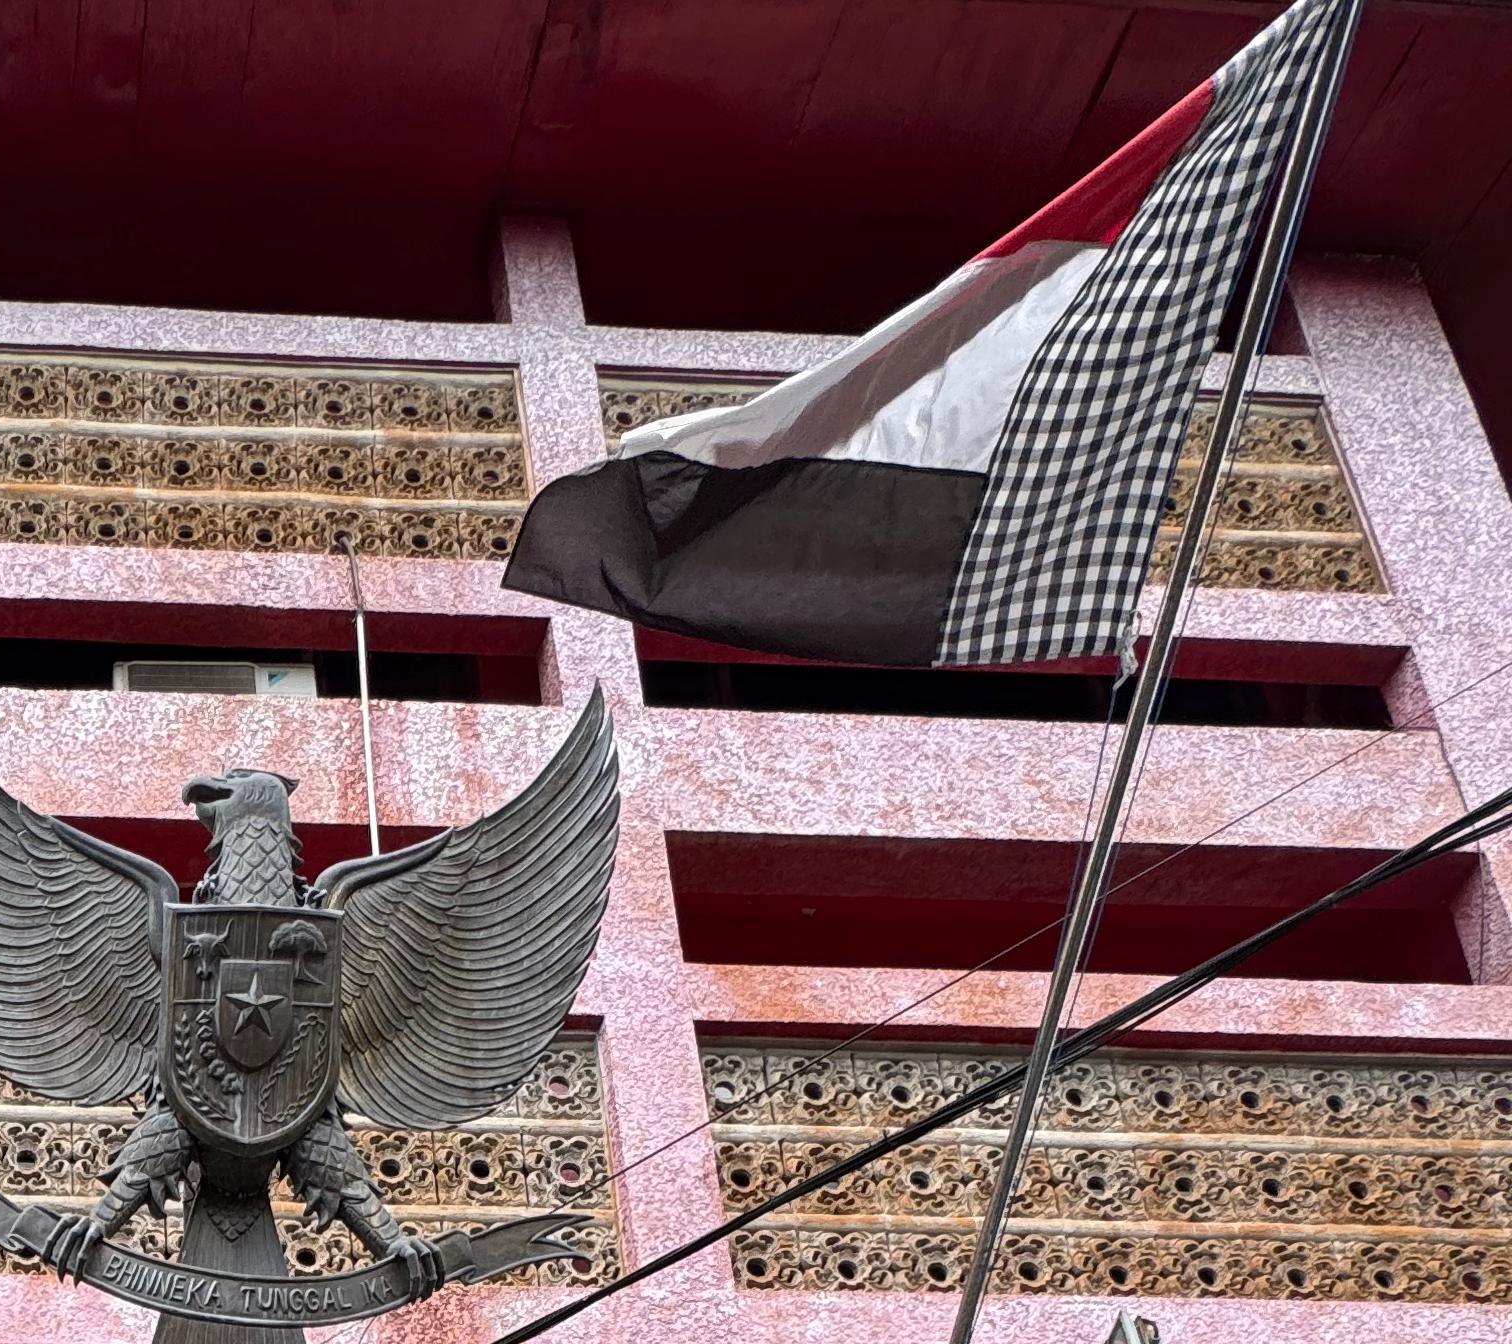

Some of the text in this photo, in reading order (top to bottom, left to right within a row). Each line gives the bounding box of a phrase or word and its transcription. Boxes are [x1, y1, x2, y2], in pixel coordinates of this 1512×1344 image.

[101, 1253, 395, 1315] BHINNEKA TUNGGAL IKA
